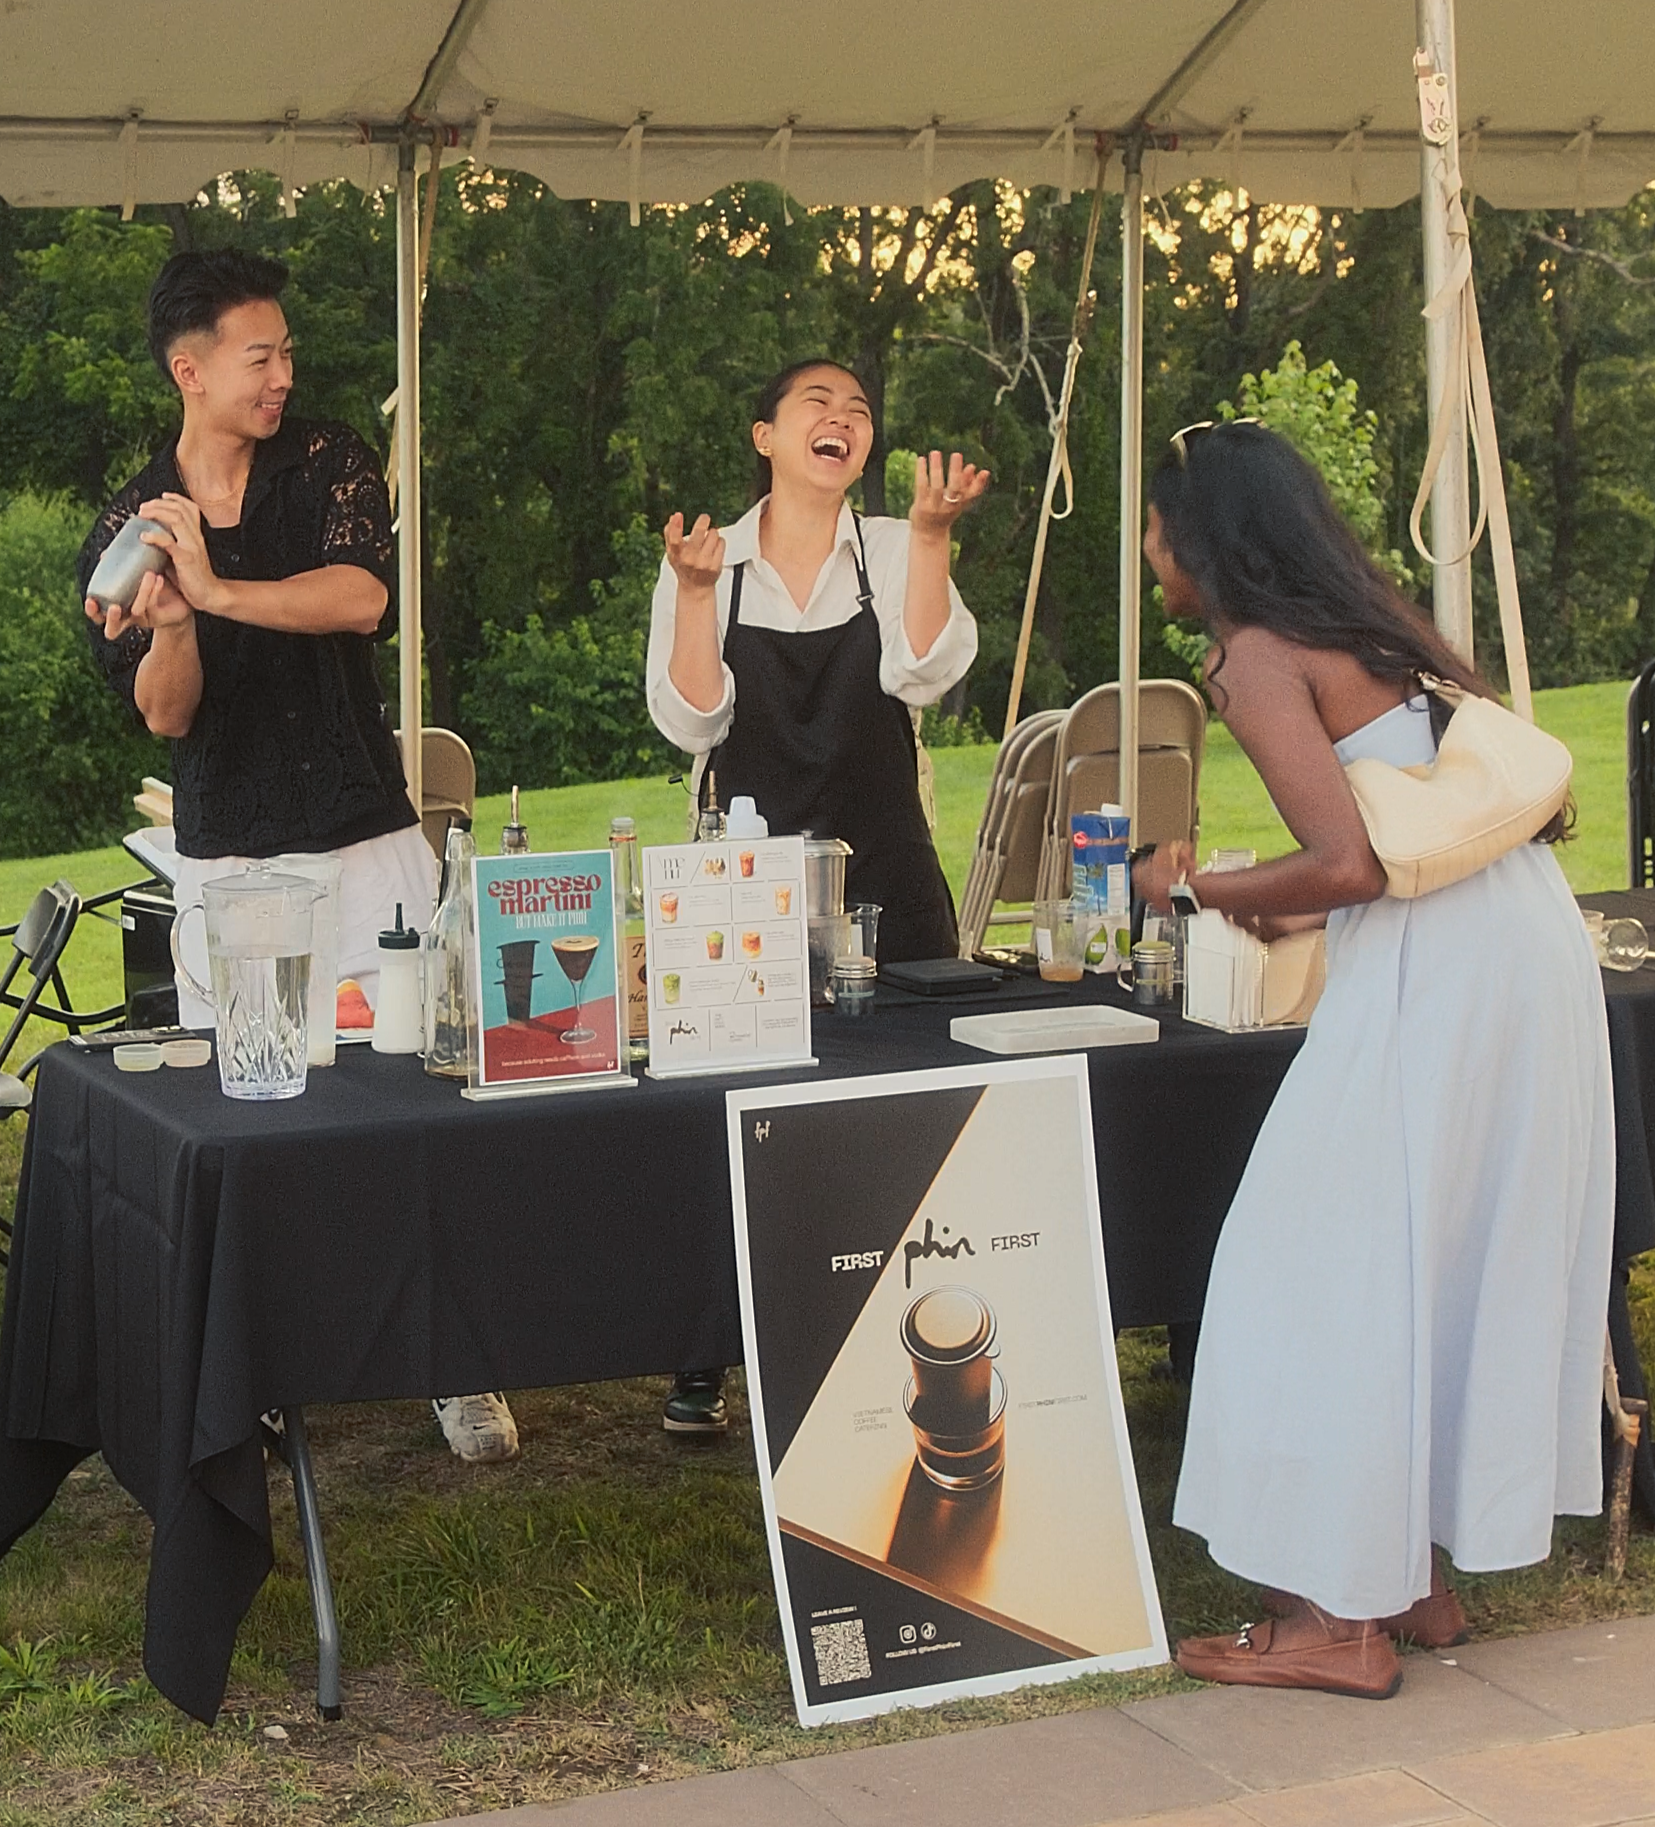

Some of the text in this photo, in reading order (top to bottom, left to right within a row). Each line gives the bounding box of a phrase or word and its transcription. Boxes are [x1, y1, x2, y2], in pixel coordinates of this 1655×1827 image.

[487, 874, 602, 899] espresso
[500, 892, 592, 915] martini
[533, 913, 557, 928] MAKE
[831, 1218, 1041, 1289] FIRST phin FIRST
